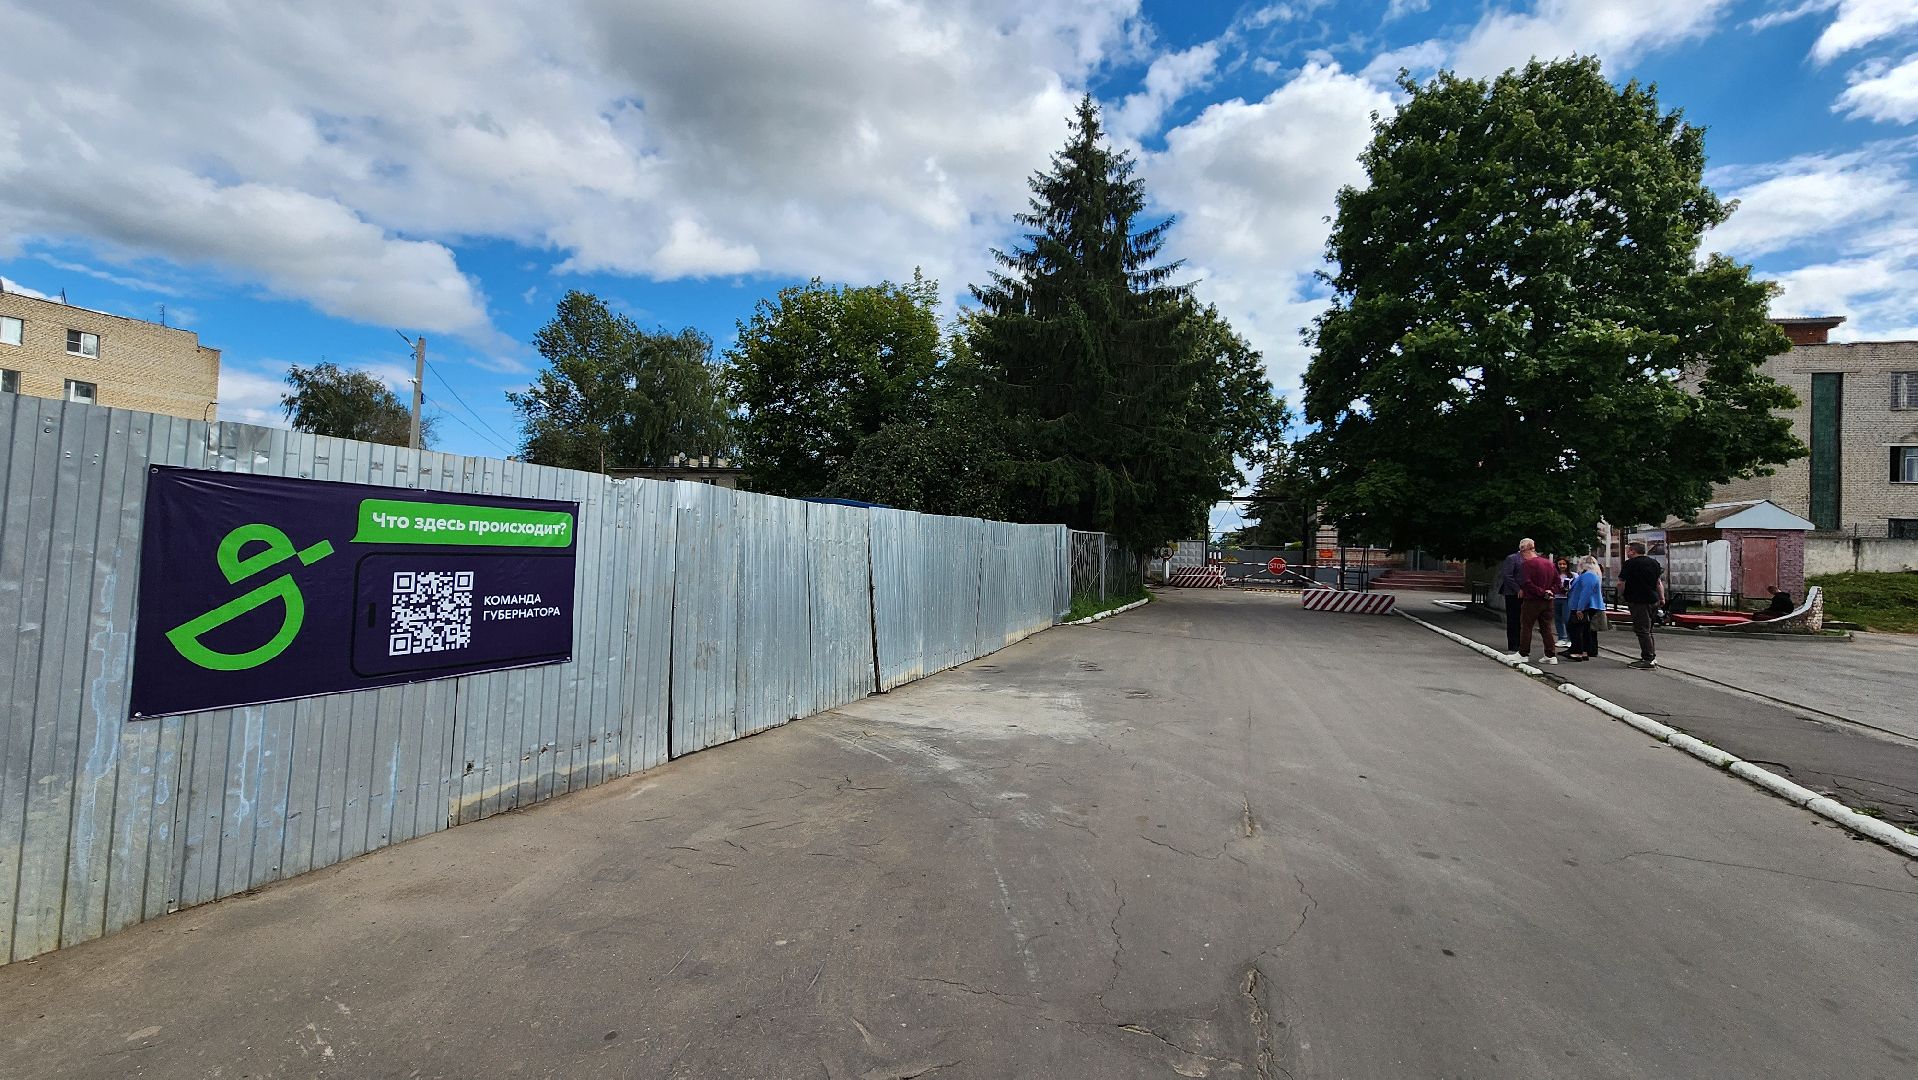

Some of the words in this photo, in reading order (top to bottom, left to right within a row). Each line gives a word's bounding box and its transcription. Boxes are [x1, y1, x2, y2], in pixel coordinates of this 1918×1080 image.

[372, 512, 410, 529] Что
[414, 516, 466, 532] здесь
[468, 520, 567, 536] происходит?
[1269, 562, 1285, 570] STOP
[484, 593, 541, 606] КОМАНДА
[483, 606, 560, 621] ГУБЕРНАТОРА
